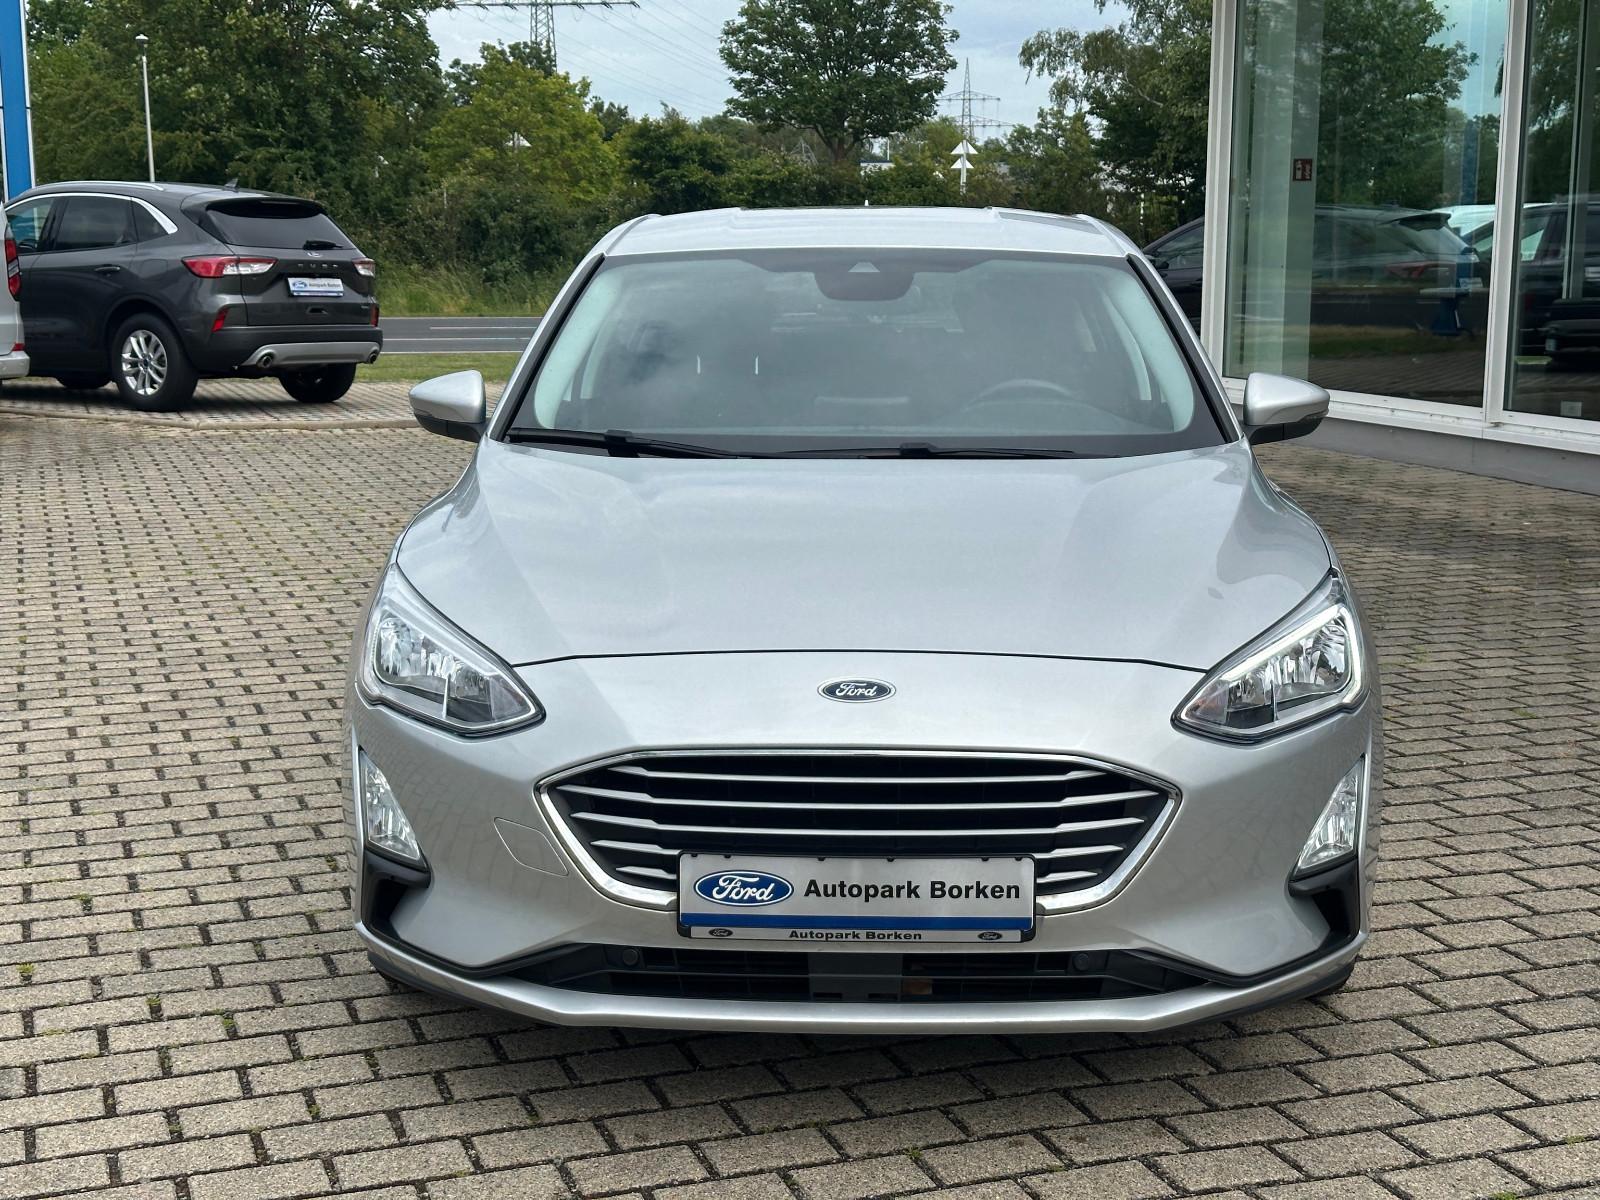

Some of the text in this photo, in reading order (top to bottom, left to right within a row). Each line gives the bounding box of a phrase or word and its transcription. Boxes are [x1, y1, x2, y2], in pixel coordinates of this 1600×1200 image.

[835, 682, 878, 697] Ford
[712, 875, 1020, 903] Ford Autopark Borken
[788, 930, 861, 942] Autopark
[865, 931, 922, 941] Borken
